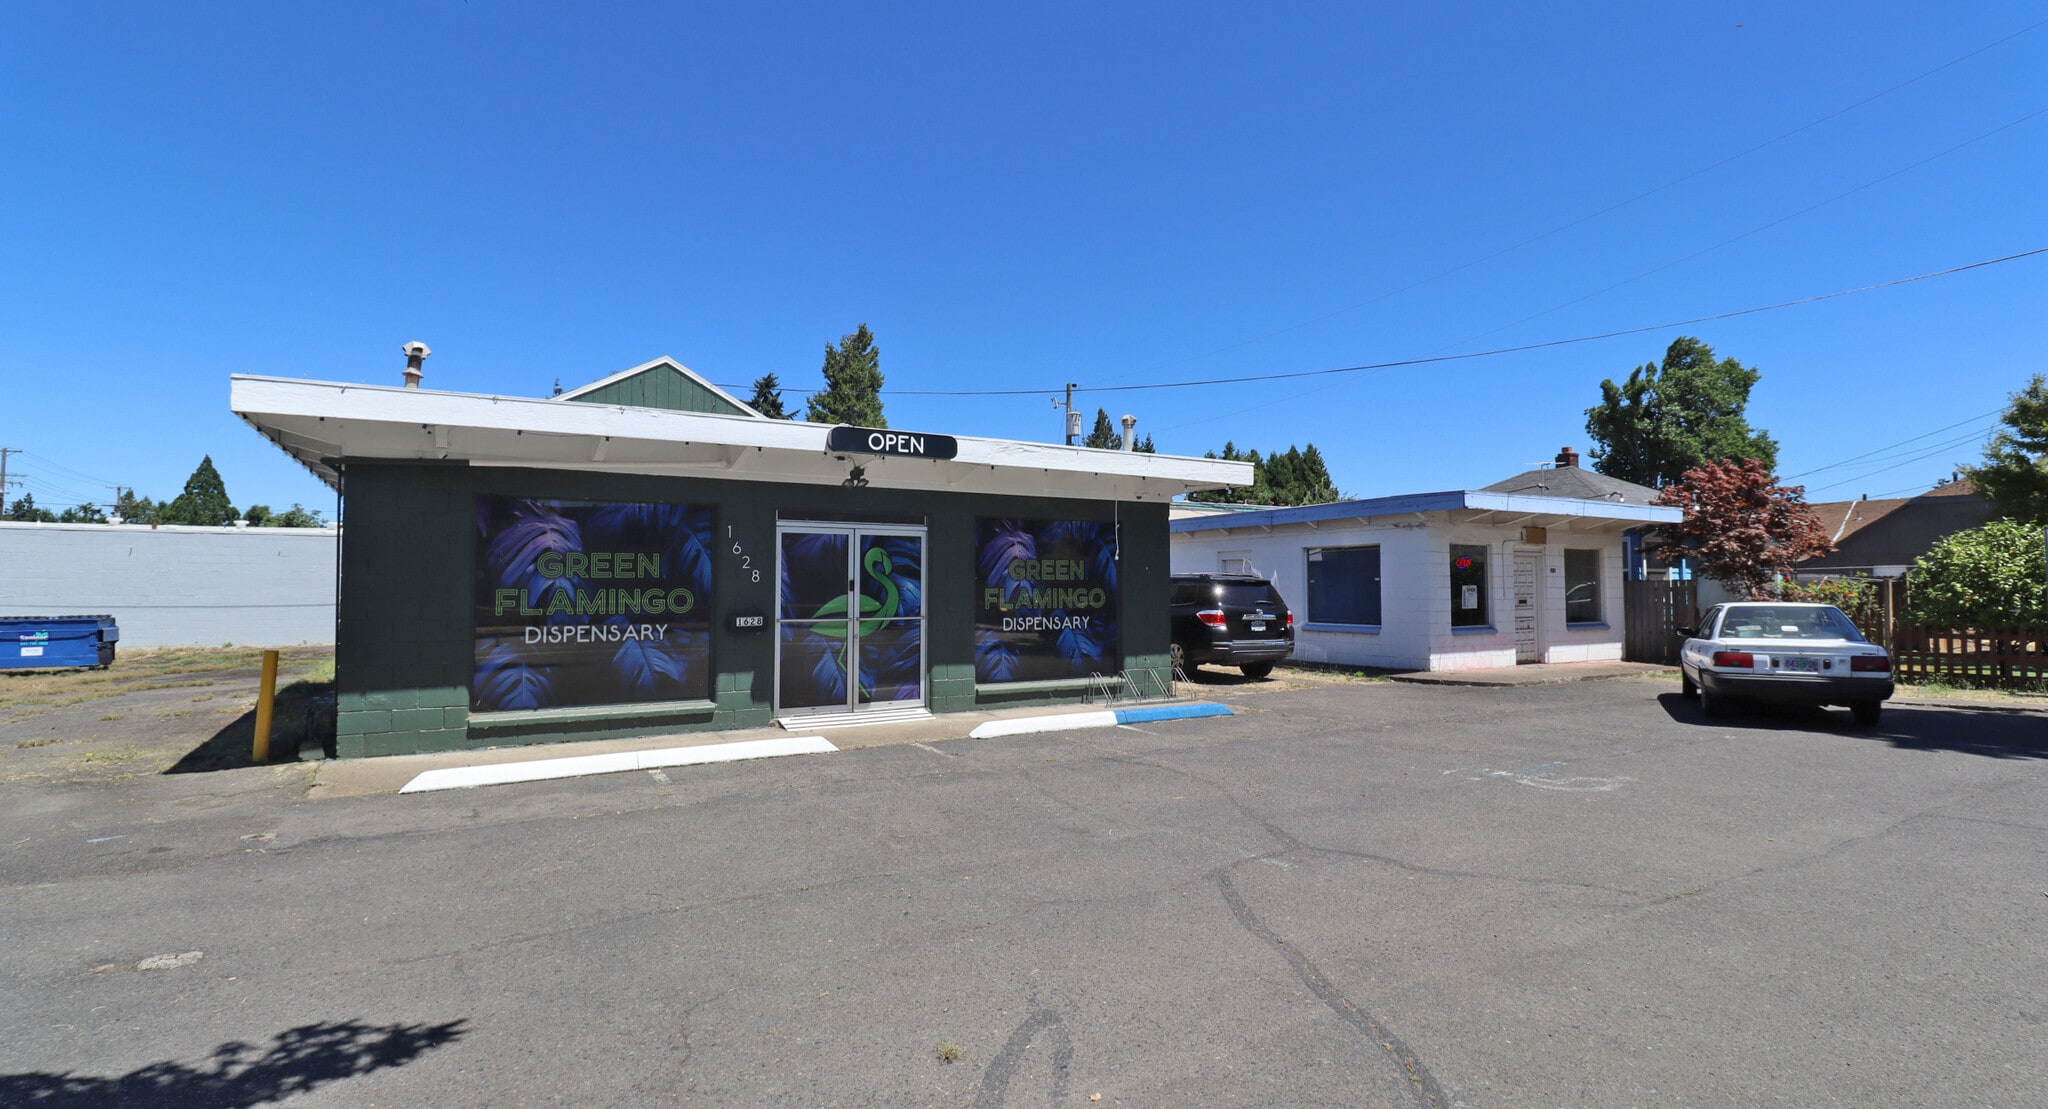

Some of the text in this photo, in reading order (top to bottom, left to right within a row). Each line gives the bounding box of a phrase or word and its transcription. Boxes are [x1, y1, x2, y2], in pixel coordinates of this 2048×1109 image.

[868, 433, 924, 454] OPEN
[728, 525, 760, 583] 1628
[537, 552, 660, 579] GREEN
[1008, 559, 1085, 580] GREEN
[495, 587, 694, 616] FLAMINGO
[984, 587, 1106, 610] FLAMINGO
[737, 617, 763, 627] 1628
[1003, 616, 1090, 631] DISPENSARY
[525, 624, 668, 644] DISPENSARY
